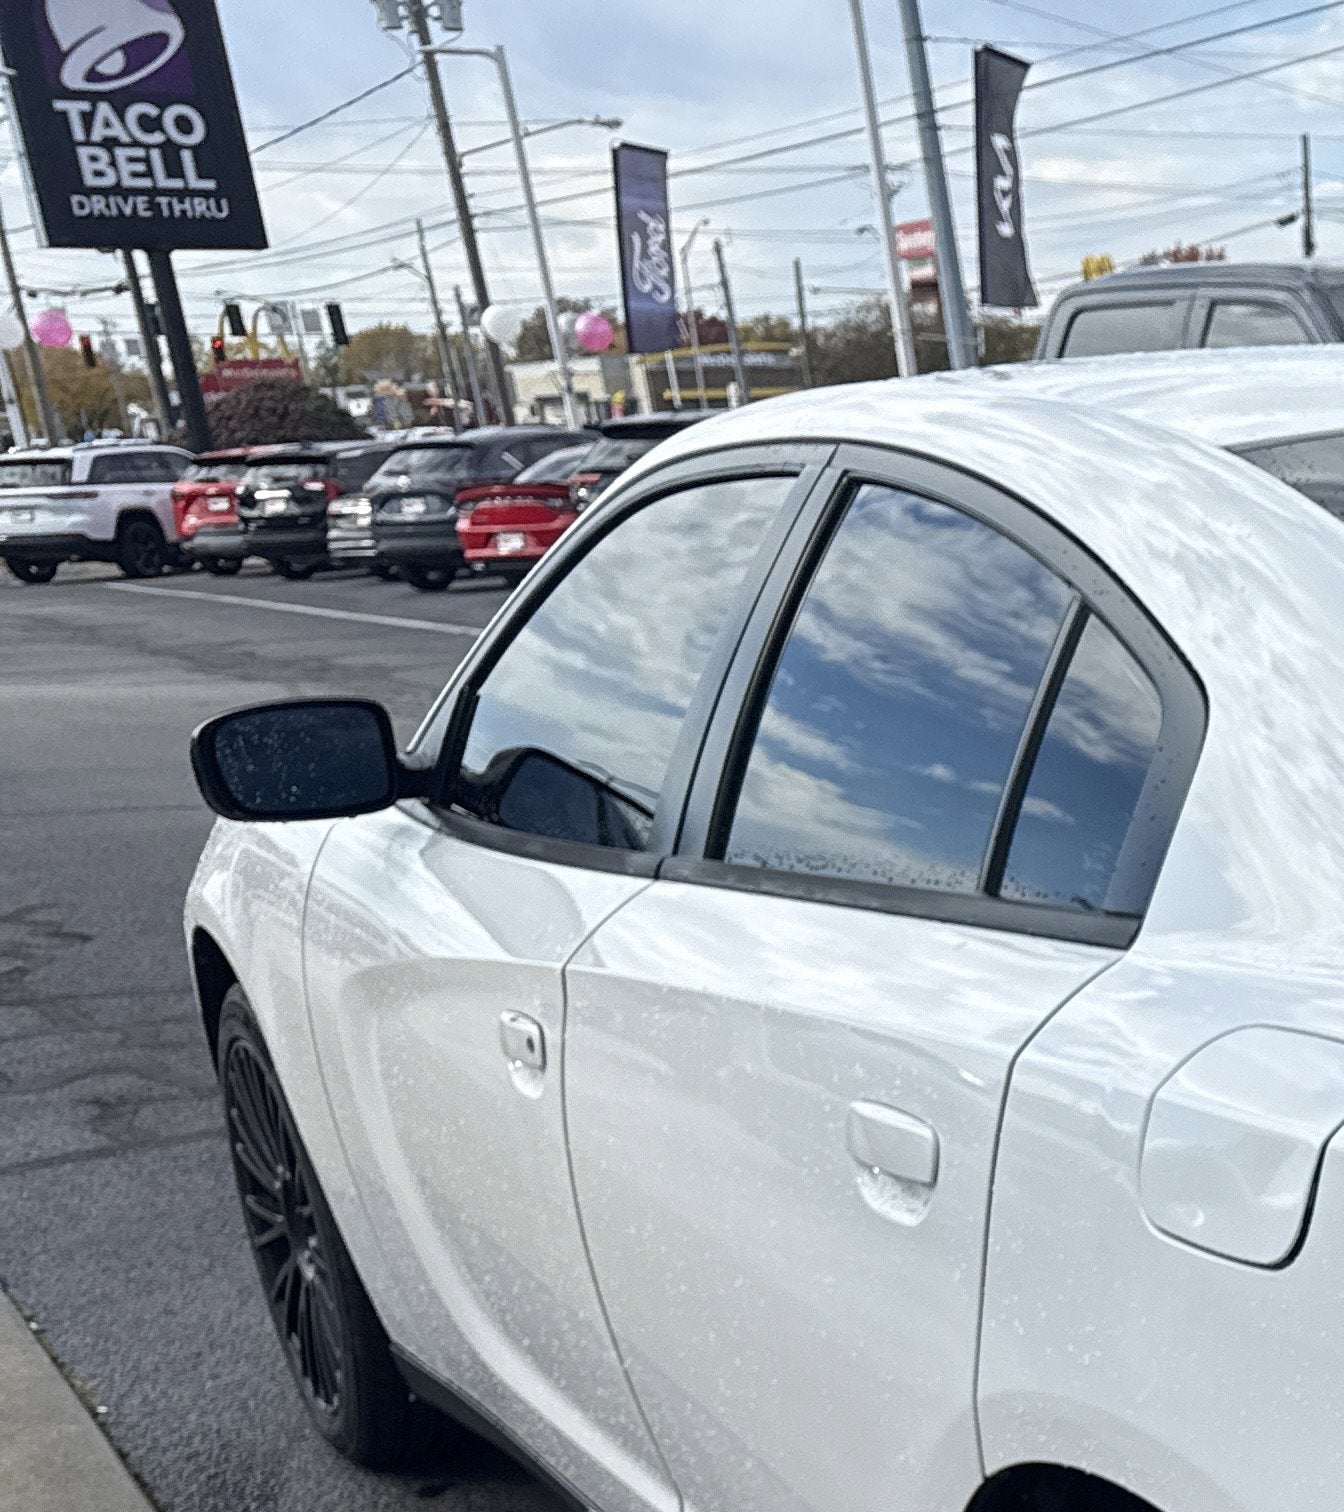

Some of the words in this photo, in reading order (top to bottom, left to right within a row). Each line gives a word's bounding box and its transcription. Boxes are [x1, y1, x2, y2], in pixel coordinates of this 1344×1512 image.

[52, 99, 207, 147] TACO
[75, 145, 217, 190] BELL
[70, 194, 153, 218] DRIVE
[154, 196, 230, 220] THRU
[631, 209, 672, 305] Ford
